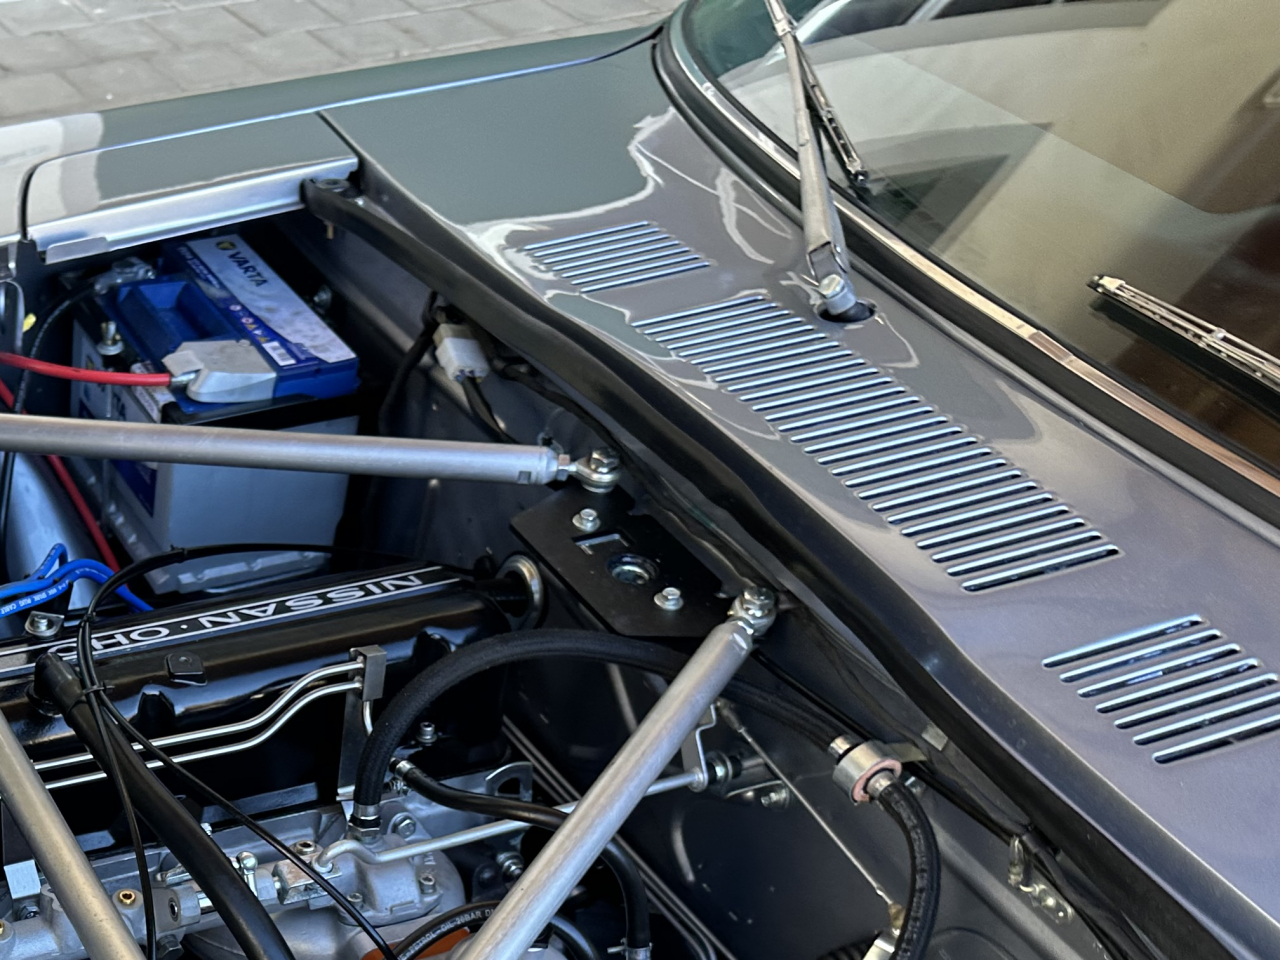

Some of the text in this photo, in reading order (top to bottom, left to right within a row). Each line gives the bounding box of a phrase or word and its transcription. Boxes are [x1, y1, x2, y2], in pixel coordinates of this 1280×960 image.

[228, 252, 268, 286] VARTA
[1, 604, 16, 614] CABLE
[199, 575, 424, 629] NISSAN
